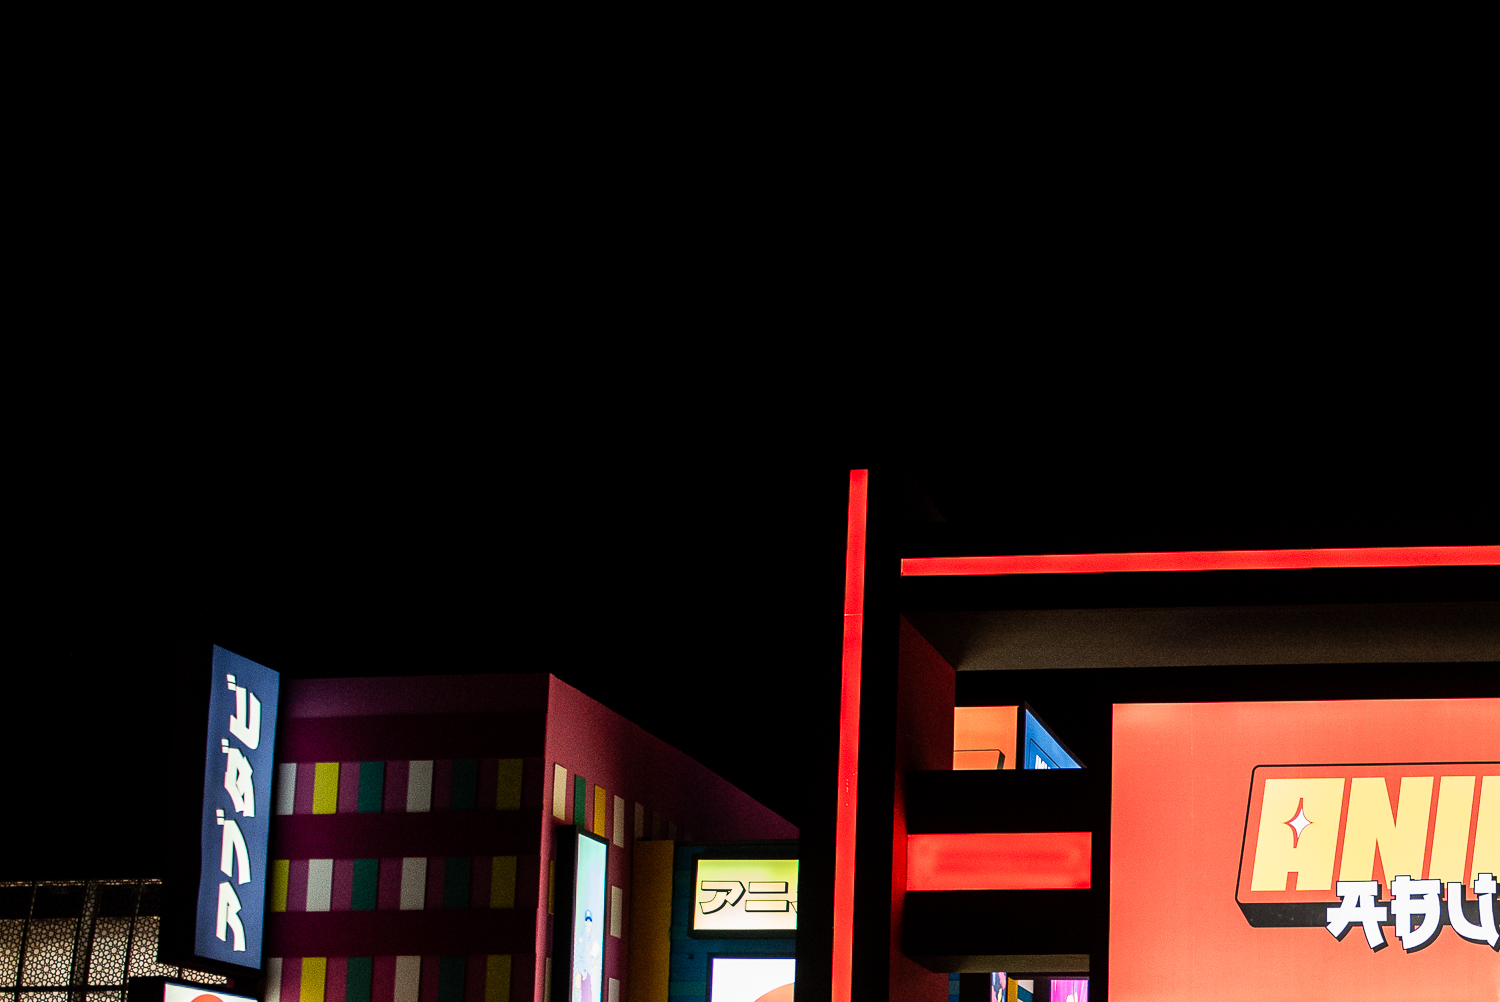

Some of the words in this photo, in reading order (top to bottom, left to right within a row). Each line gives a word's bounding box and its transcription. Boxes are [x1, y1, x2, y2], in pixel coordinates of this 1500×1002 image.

[215, 673, 261, 952] アブダビ
[699, 880, 798, 915] アニ
